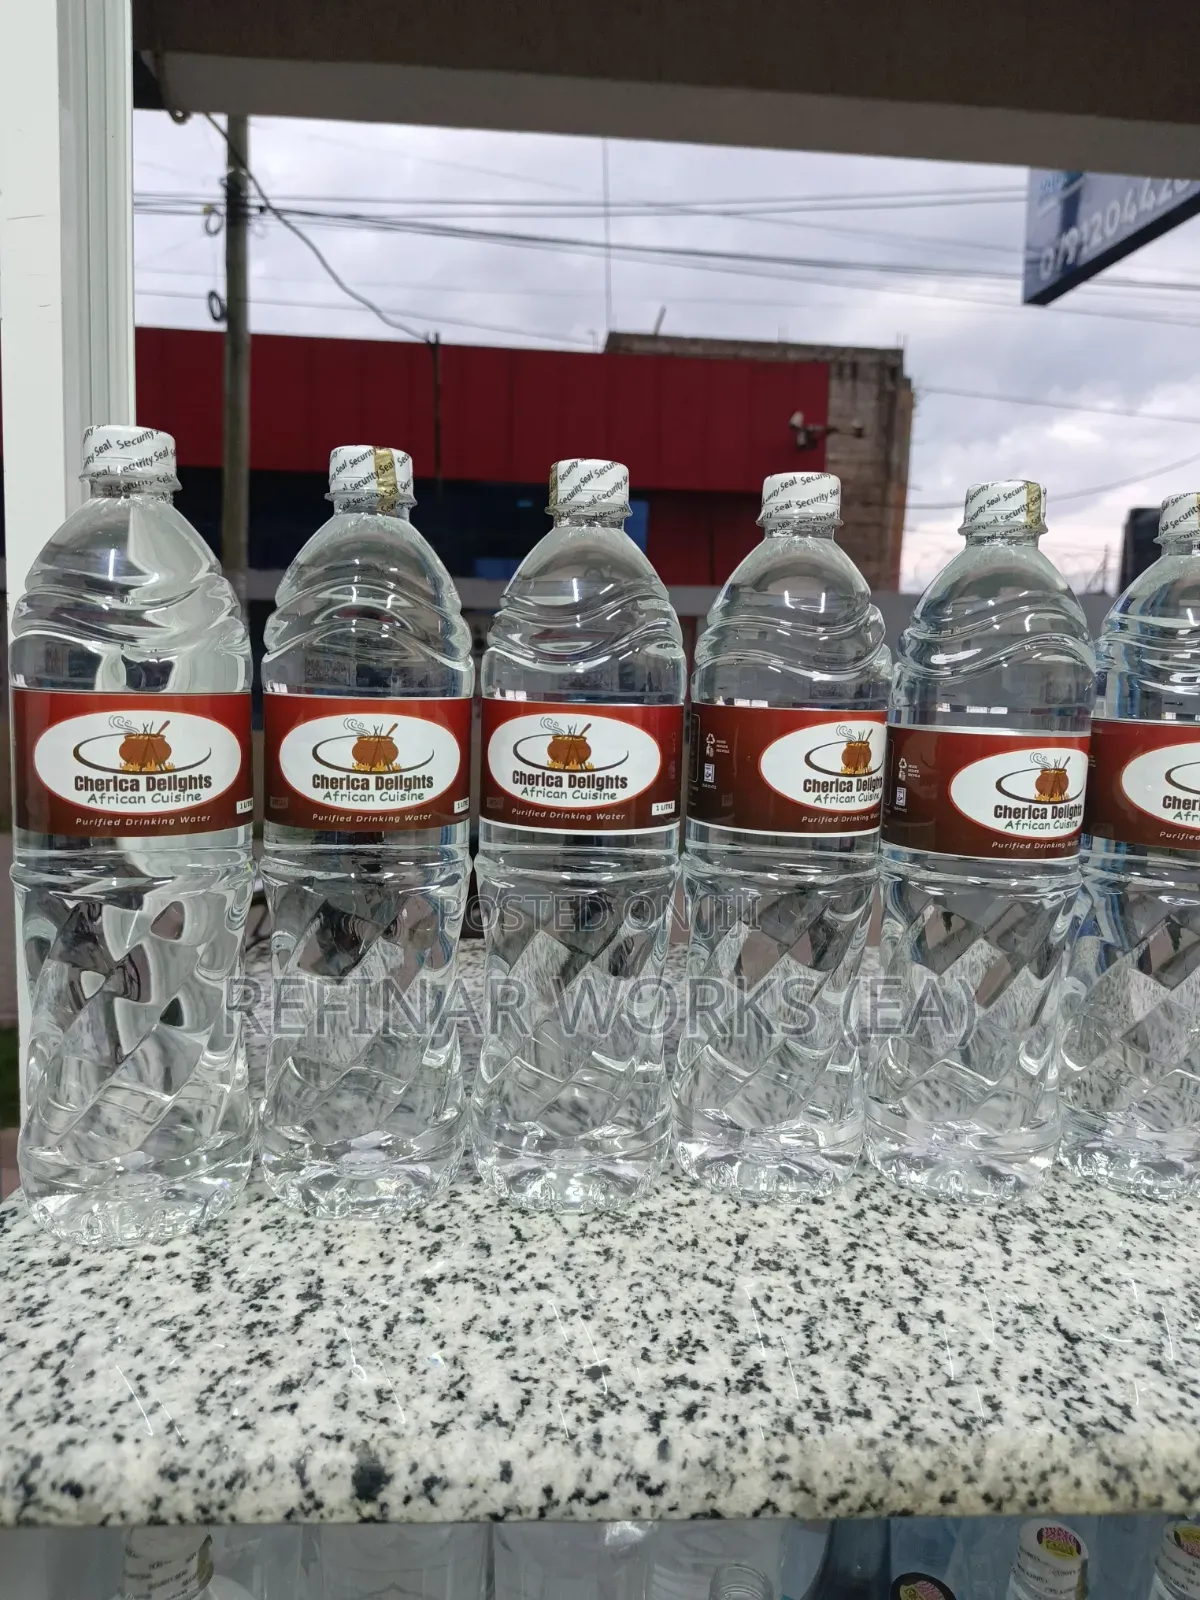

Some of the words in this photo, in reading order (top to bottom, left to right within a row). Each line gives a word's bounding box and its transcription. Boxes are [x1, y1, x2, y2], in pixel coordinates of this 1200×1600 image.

[94, 439, 112, 457] Seal
[116, 430, 154, 449] Security
[154, 447, 169, 461] Seal
[335, 460, 348, 476] Seal
[349, 447, 377, 468] Security
[350, 470, 380, 491] Security
[379, 460, 395, 474] Seal
[559, 460, 578, 483] Security
[384, 484, 399, 496] Seal
[559, 483, 583, 506] Security
[580, 470, 594, 487] Seal
[594, 461, 618, 478] Secur
[597, 480, 623, 501] Security
[780, 476, 797, 492] Seal
[775, 500, 792, 513] Seal
[796, 493, 828, 509] Security
[986, 493, 1001, 508] Seal
[1002, 484, 1029, 501] Security
[74, 775, 141, 792] Cherica
[145, 774, 212, 794] Delights
[312, 773, 370, 791] Cherica
[375, 774, 434, 793] Delights
[512, 770, 563, 788] Cherica
[567, 774, 628, 792] Delights
[803, 778, 853, 793] Cherica
[87, 793, 147, 804] African
[151, 791, 202, 804] Cuisine
[322, 791, 375, 802] African
[379, 791, 425, 802] Cuisine
[521, 788, 568, 799] African
[572, 789, 617, 800] Cuisine
[813, 794, 856, 804] African
[1162, 795, 1200, 811] Cher
[312, 813, 352, 823] Purified
[356, 815, 400, 824] Drinking
[404, 813, 433, 821] Water
[511, 808, 546, 818] Purified
[549, 811, 592, 821] Drinking
[594, 812, 626, 821] Water
[801, 815, 838, 825] Purified
[841, 814, 869, 823] Drinking
[993, 804, 1048, 820] Cherica
[75, 817, 121, 827] Purified
[125, 817, 175, 826] Drinking
[180, 815, 212, 824] Water
[1004, 820, 1051, 830] African
[991, 841, 1031, 850] Purified
